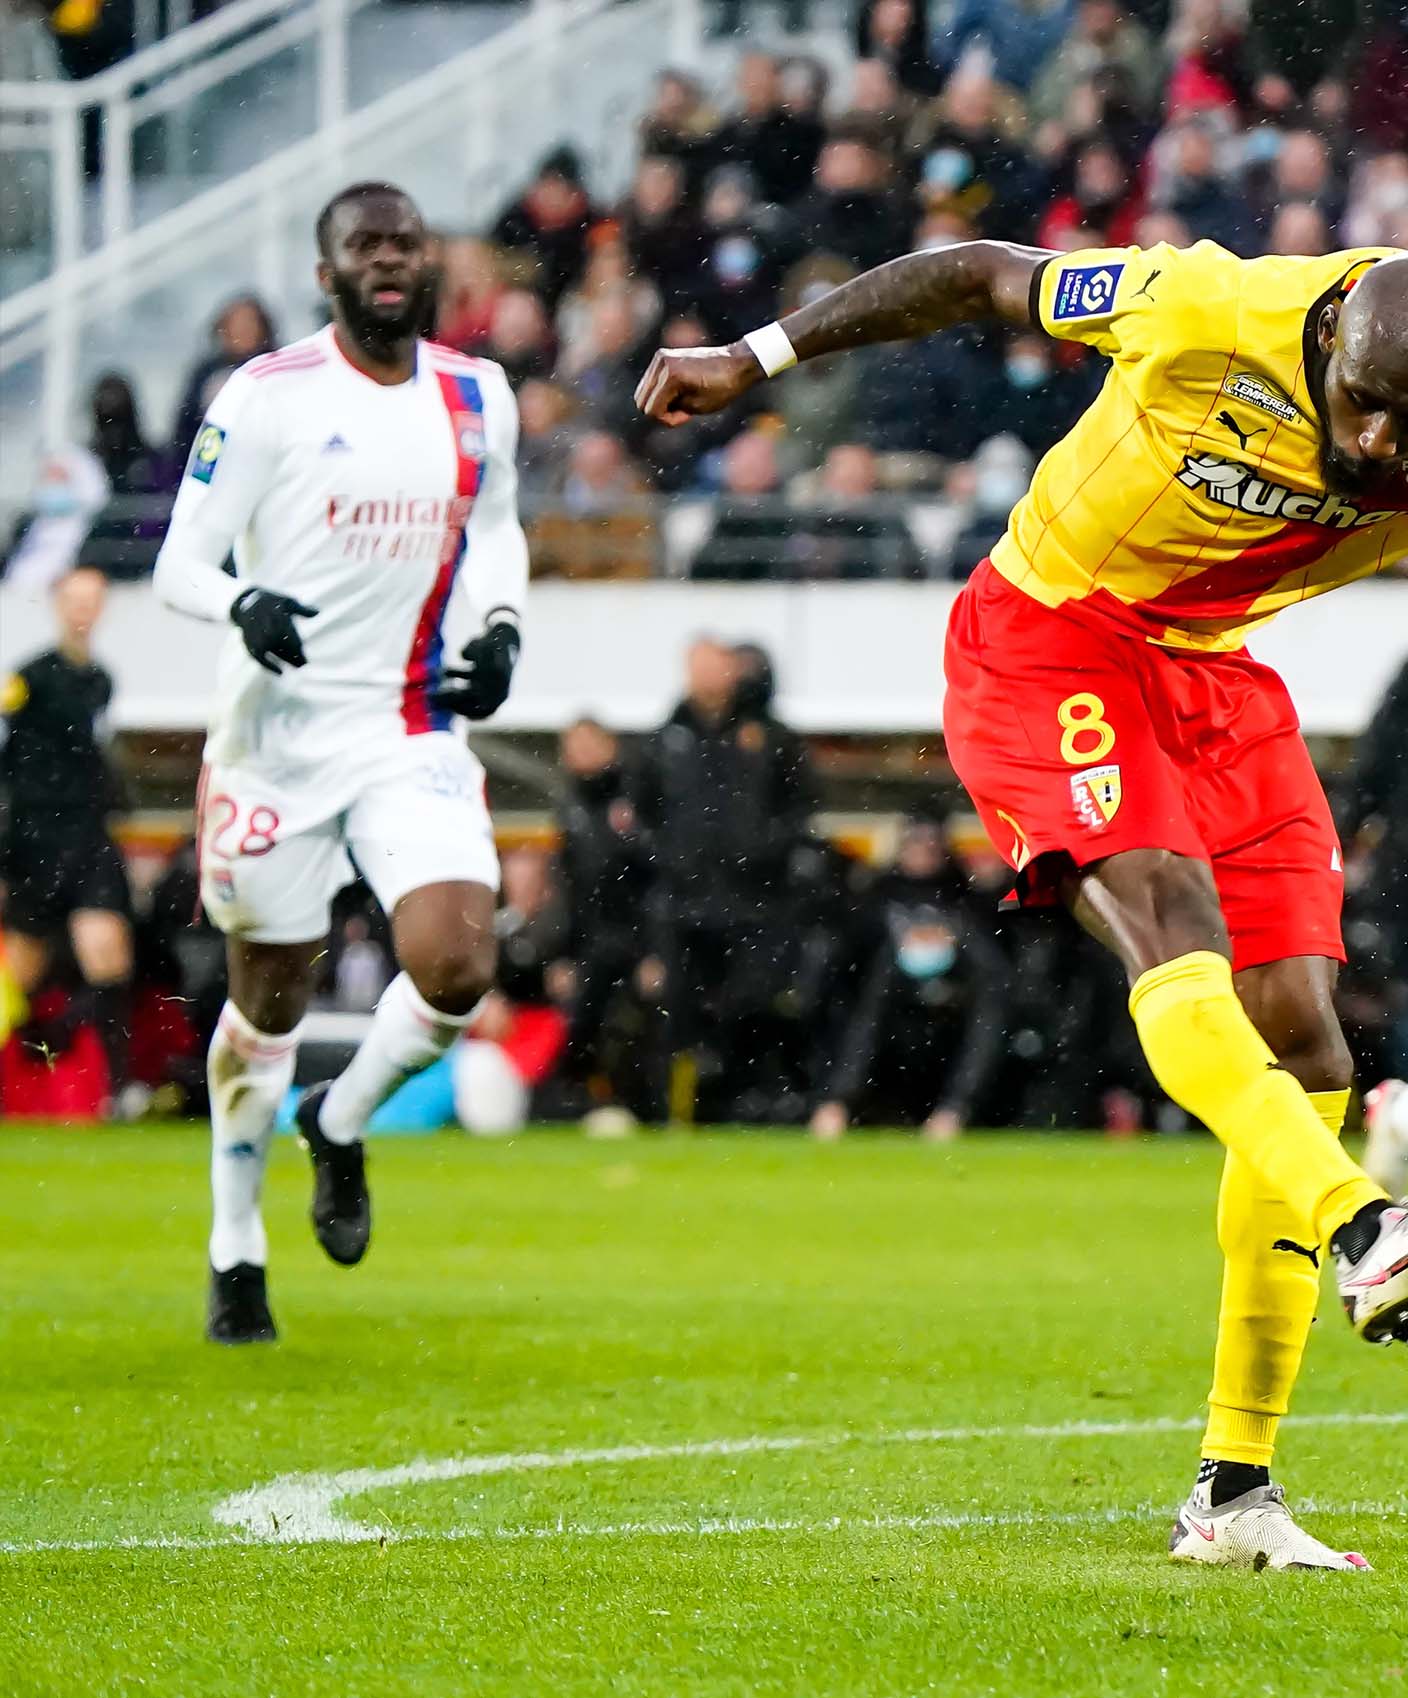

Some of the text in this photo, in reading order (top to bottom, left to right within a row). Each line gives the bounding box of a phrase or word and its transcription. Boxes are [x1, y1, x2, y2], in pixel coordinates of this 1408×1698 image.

[1233, 382, 1297, 417] LEMPEREUR
[1057, 692, 1116, 765] 8
[210, 796, 280, 860] 28
